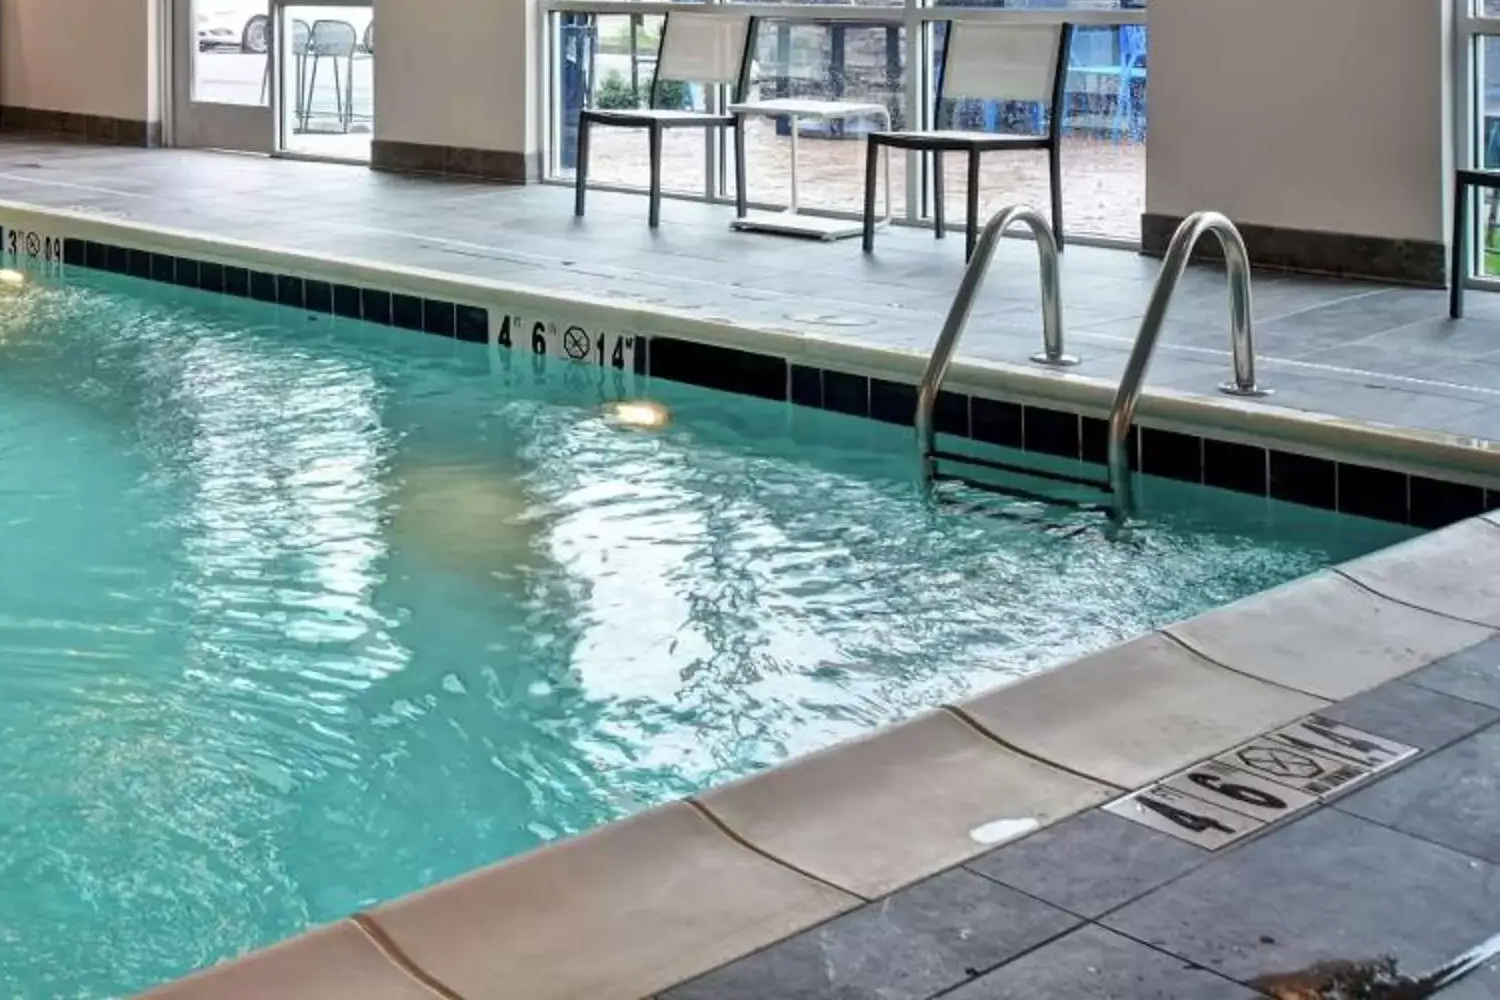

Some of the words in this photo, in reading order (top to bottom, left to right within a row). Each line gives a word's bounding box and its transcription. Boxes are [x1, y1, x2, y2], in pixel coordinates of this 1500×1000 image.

[8, 230, 17, 256] 3
[498, 315, 512, 348] 4
[532, 321, 546, 354] 6
[1136, 797, 1237, 833] 4
[1187, 773, 1288, 809] 6
